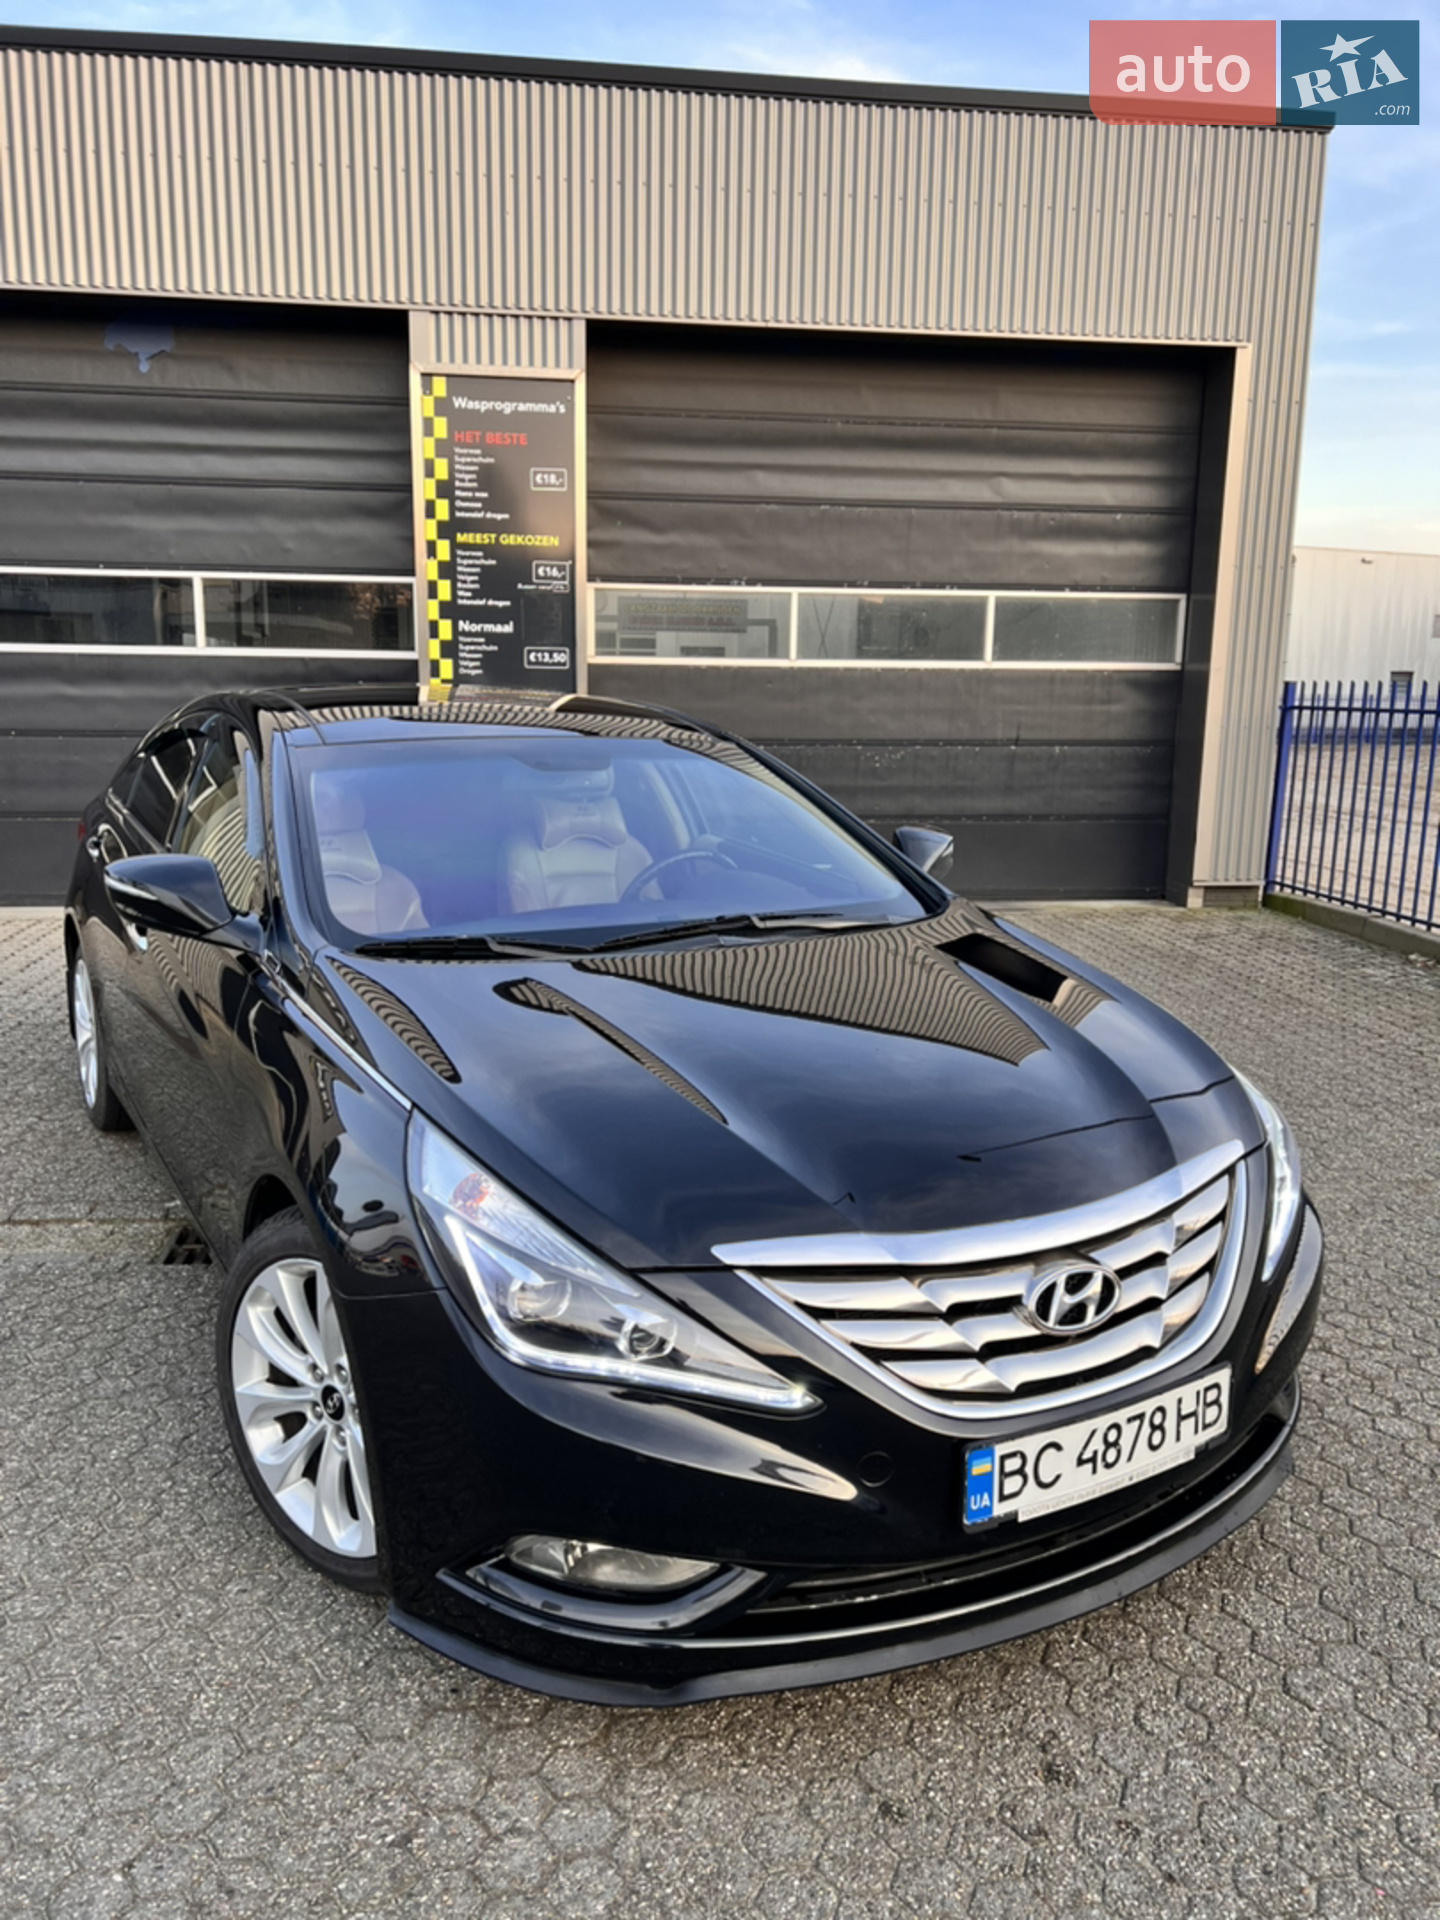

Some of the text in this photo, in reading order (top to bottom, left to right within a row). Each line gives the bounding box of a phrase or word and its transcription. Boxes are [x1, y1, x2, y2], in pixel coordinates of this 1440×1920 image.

[452, 395, 566, 414] Wasprogramma's
[454, 430, 528, 445] HET BESTE
[456, 533, 559, 546] MEEST GEKOZEN
[458, 620, 514, 633] Normaal
[529, 651, 567, 664] €13,50
[998, 1441, 1064, 1504] BC
[1075, 1405, 1168, 1476] 4878
[1175, 1382, 1224, 1443] HB
[970, 1491, 991, 1511] UA
